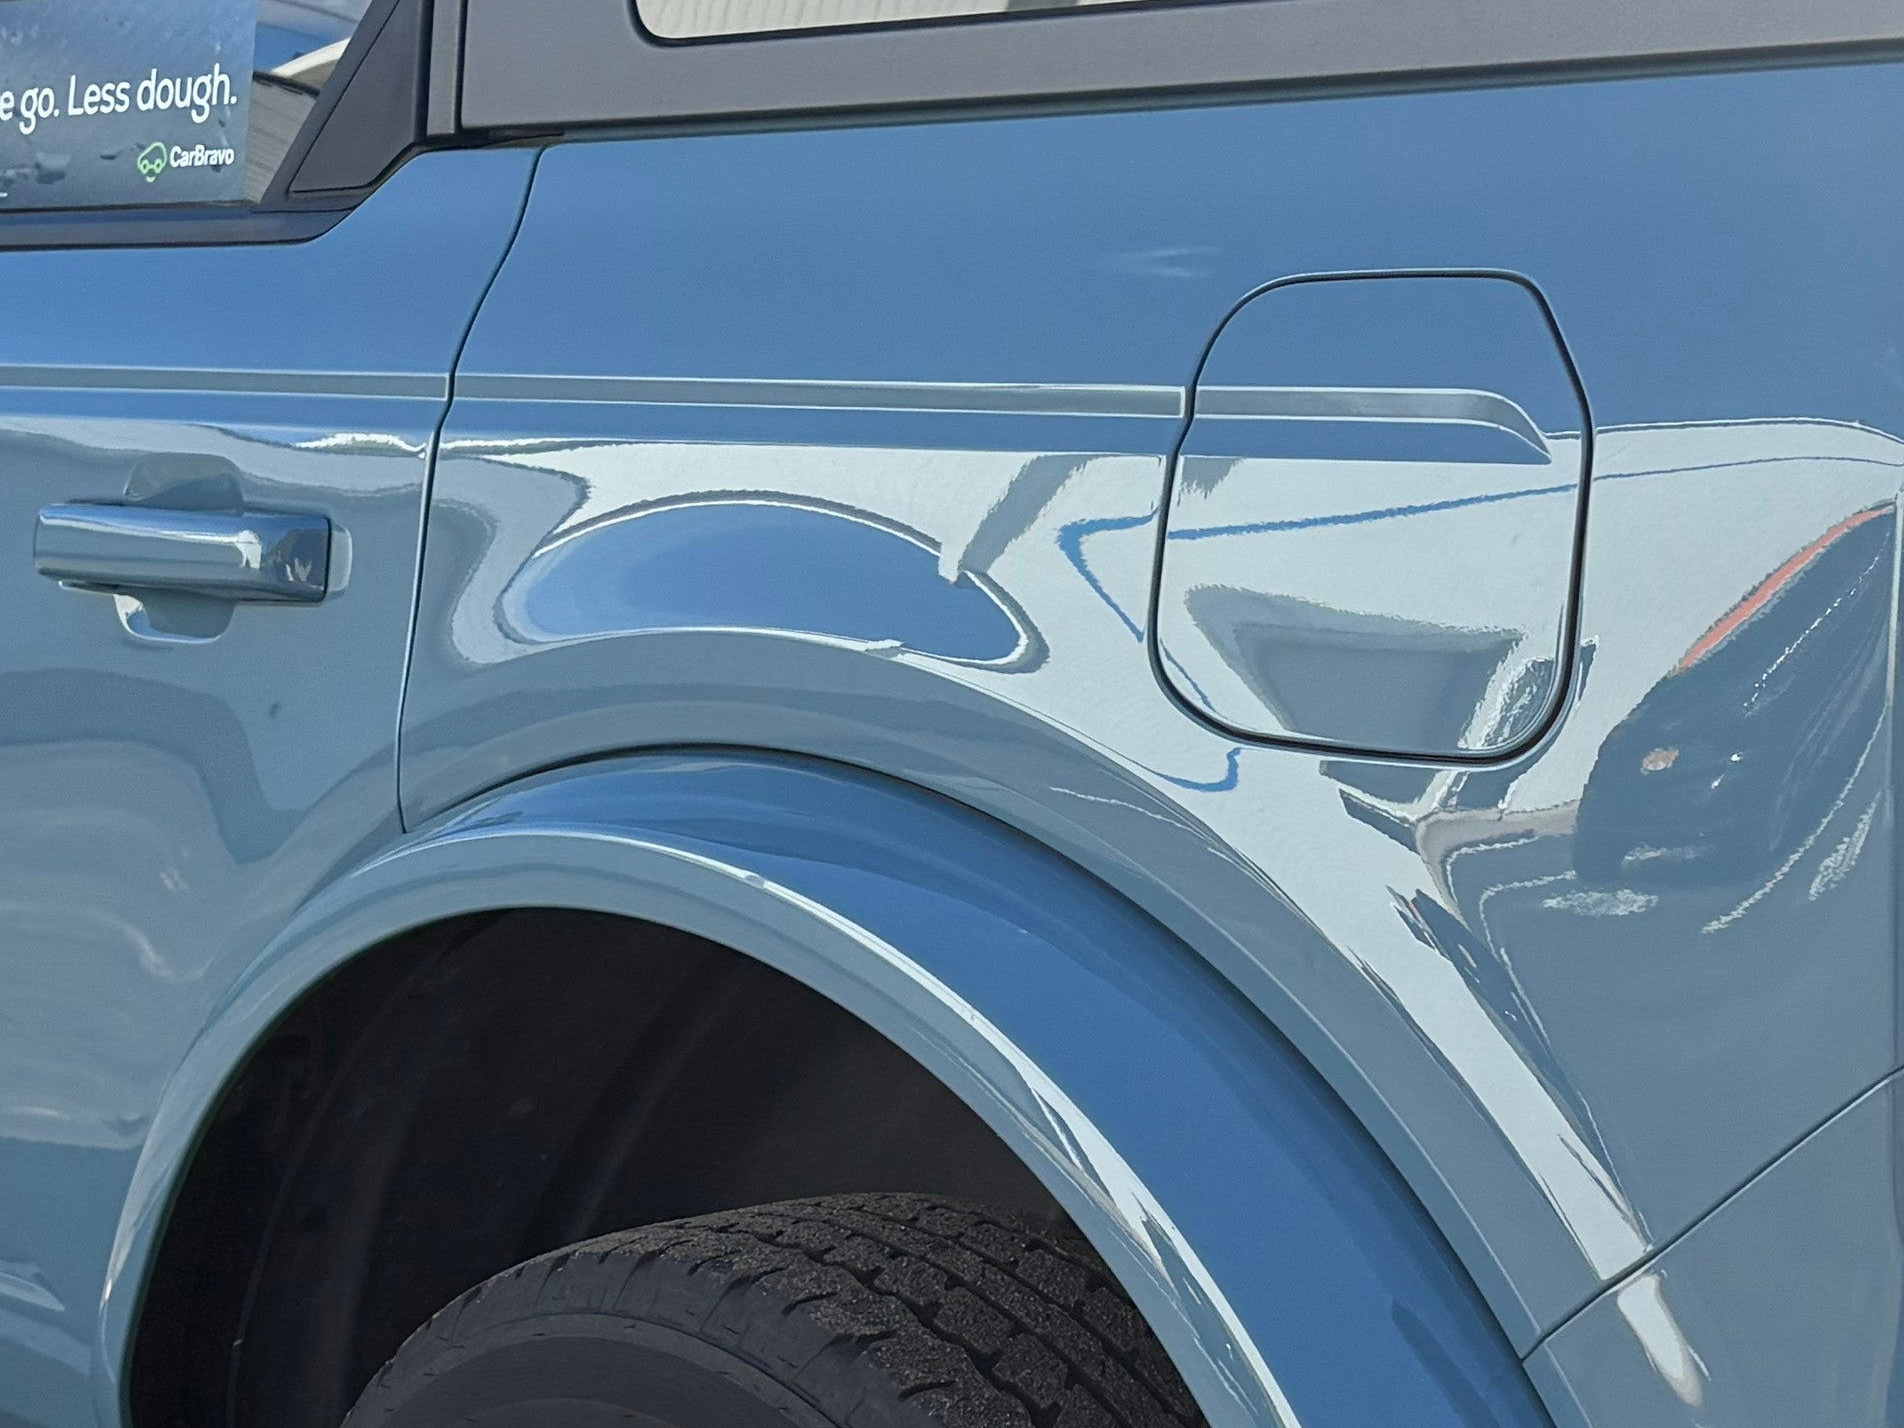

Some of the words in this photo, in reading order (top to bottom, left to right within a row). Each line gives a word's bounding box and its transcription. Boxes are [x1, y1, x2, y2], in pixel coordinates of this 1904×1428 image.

[18, 86, 60, 135] go.
[67, 74, 131, 117] Less
[136, 62, 238, 124] dough.
[169, 143, 236, 169] CarBravo
